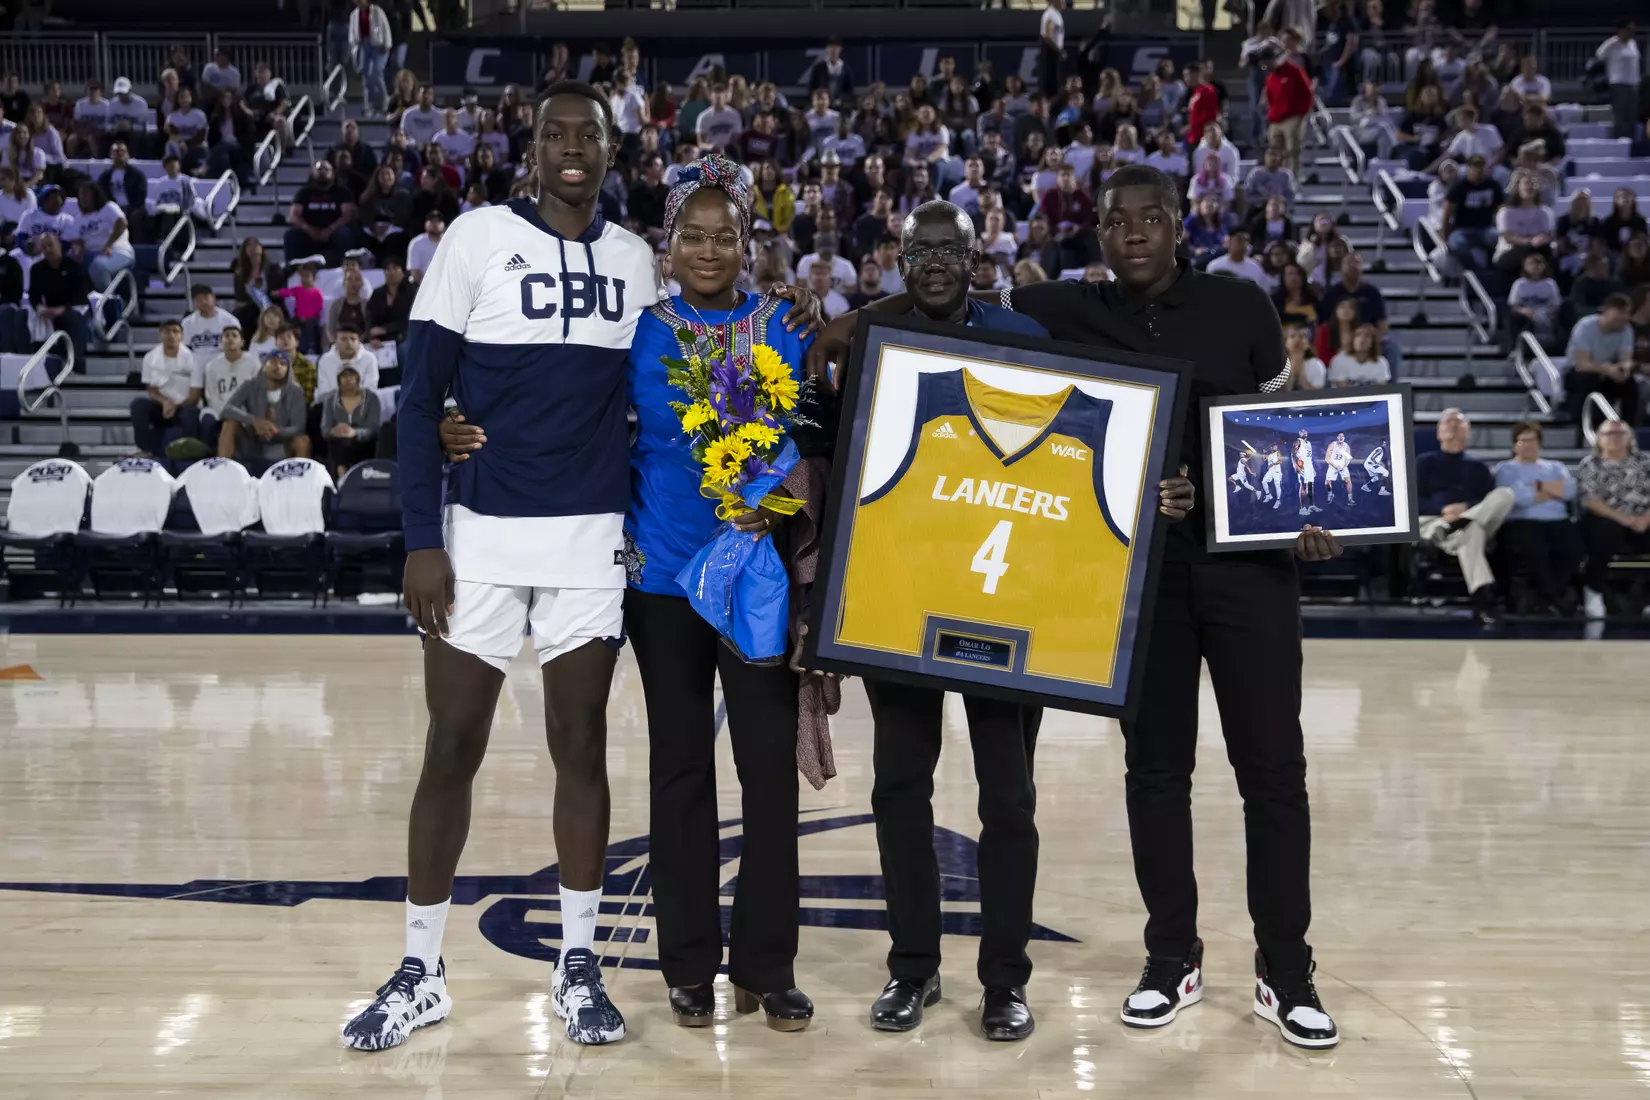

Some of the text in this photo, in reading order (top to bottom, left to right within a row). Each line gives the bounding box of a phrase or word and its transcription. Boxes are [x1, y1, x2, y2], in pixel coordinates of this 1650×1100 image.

[504, 264, 531, 272] adidas
[520, 272, 626, 322] CBU
[932, 431, 958, 440] adidas
[1051, 442, 1088, 461] WAC
[932, 475, 1070, 521] LANCERS
[970, 520, 1014, 595] 4
